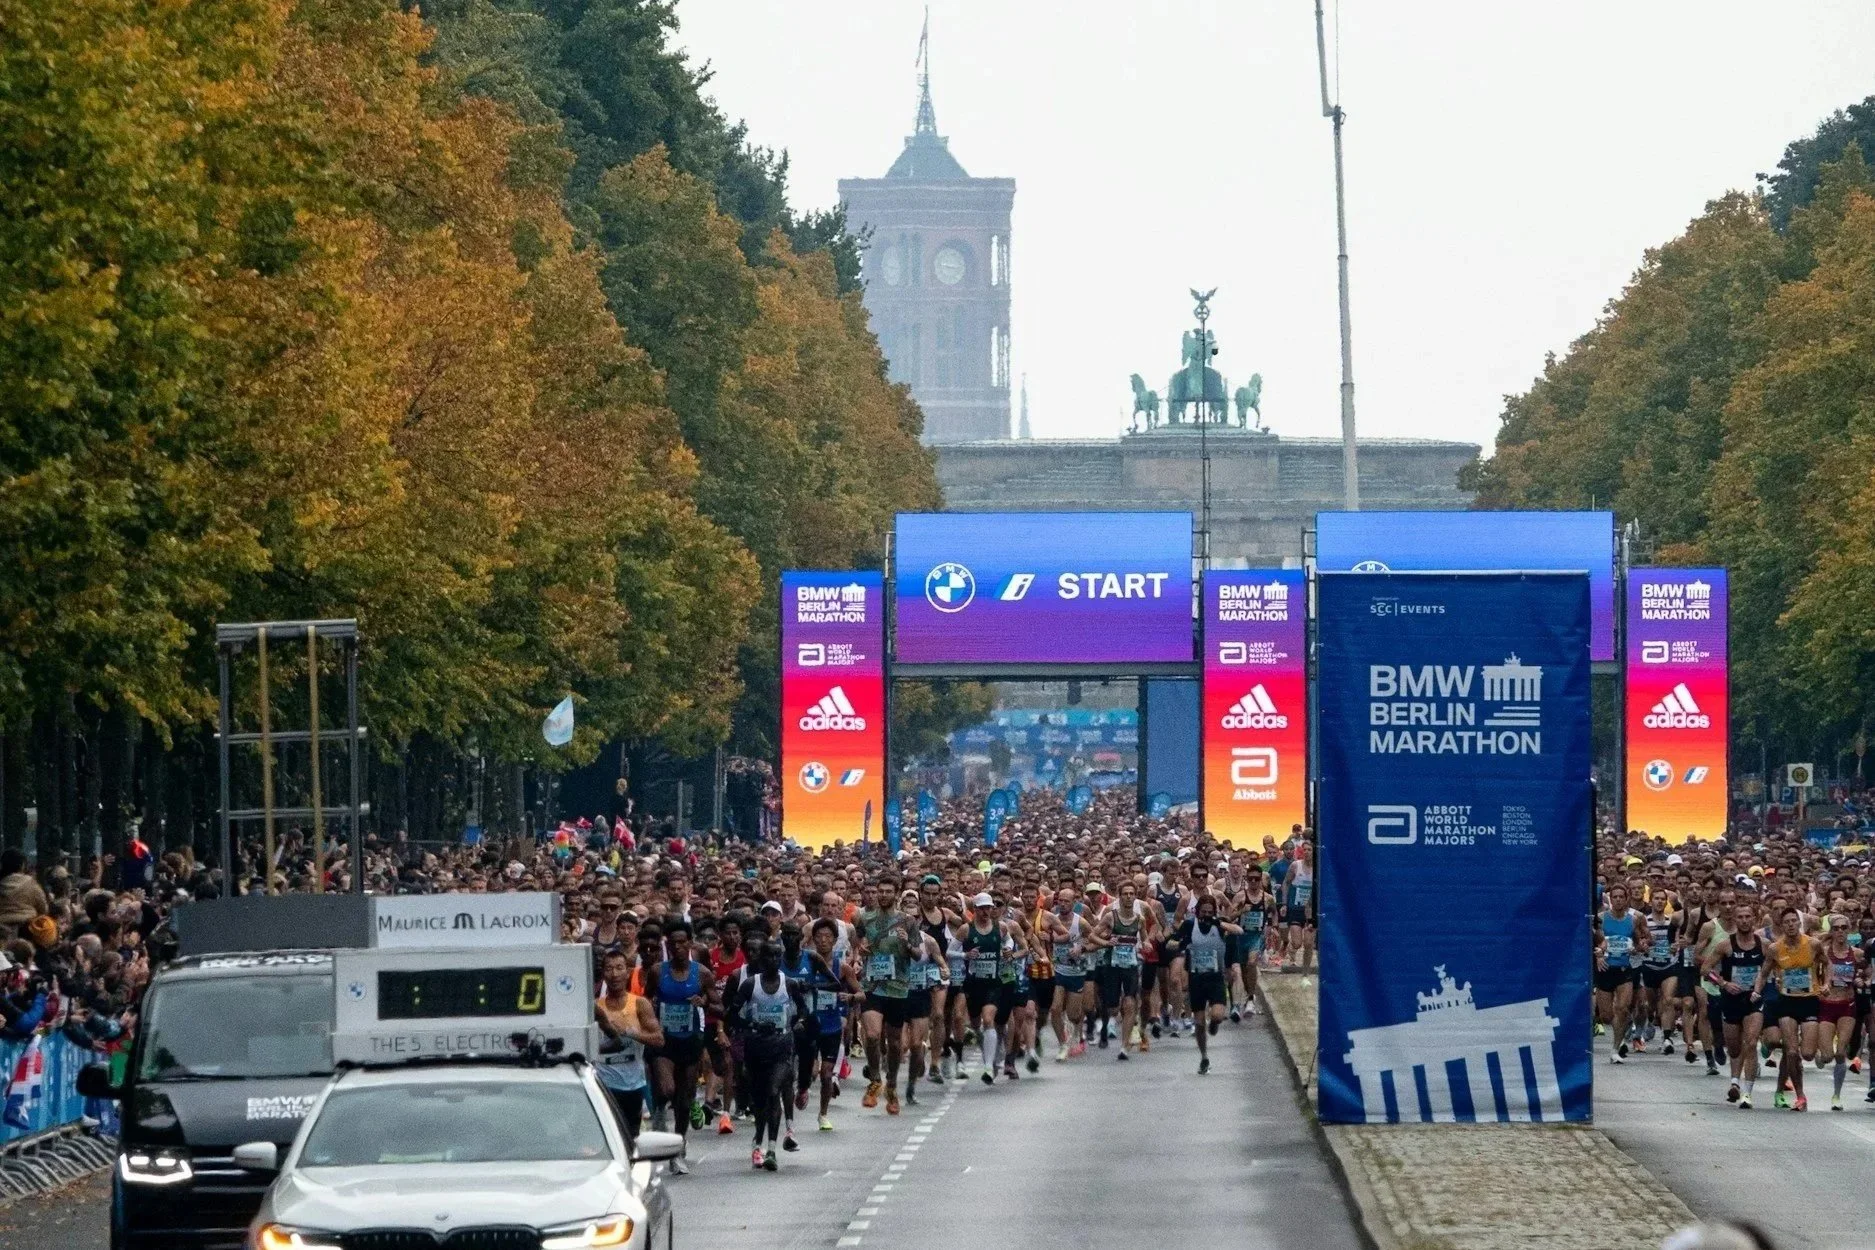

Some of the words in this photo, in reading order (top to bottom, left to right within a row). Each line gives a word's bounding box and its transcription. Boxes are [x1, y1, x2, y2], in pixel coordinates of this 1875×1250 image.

[1058, 572, 1169, 600] START
[1219, 584, 1261, 599] BMW
[1642, 583, 1684, 598] BMW
[797, 586, 841, 601] BMW
[797, 601, 841, 612] BERLIN
[1219, 600, 1262, 610] BERLIN
[1370, 603, 1392, 616] SCC
[1400, 605, 1446, 614] EVENTS
[1642, 598, 1685, 609] BERLIN
[797, 611, 866, 623] MARATHON
[1219, 610, 1288, 621] MARATHON
[1642, 609, 1710, 620] MARATHON
[1370, 665, 1475, 697] BMW
[1221, 711, 1289, 729] adidas
[1370, 702, 1475, 725] BERLIN
[1643, 711, 1711, 729] adidas
[799, 713, 867, 731] adidas
[1370, 731, 1540, 754] MARATHON
[1233, 789, 1277, 801] Abbott
[1424, 806, 1472, 815] ABBOTT
[1424, 815, 1468, 825] WORLD
[1424, 826, 1496, 835] MARATHON
[1424, 836, 1475, 846] MAJORS
[379, 914, 447, 932] MAURICE
[481, 913, 550, 929] LACROIX
[517, 973, 544, 1011] 0
[370, 1036, 407, 1052] THE
[247, 1096, 303, 1107] BMW
